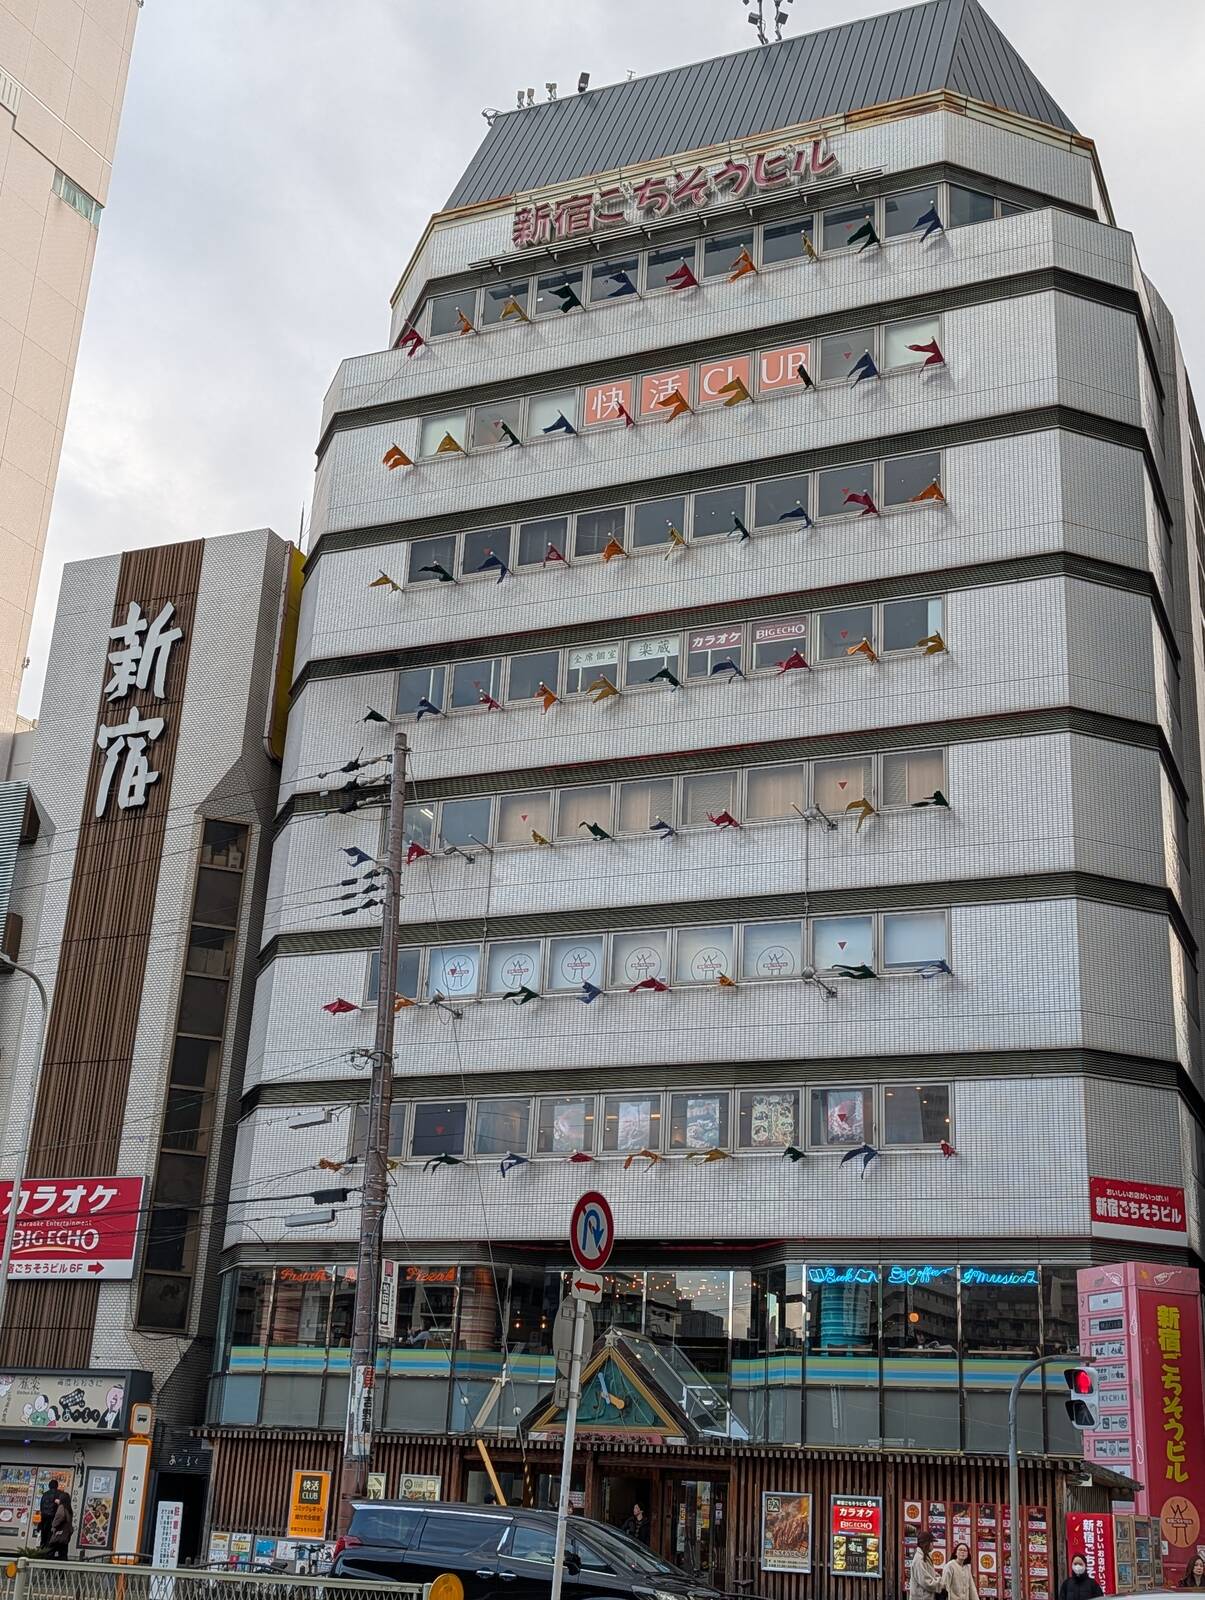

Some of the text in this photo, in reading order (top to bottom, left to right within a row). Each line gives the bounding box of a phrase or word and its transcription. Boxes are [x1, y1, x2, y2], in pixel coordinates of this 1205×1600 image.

[512, 140, 839, 249] 新宿ごちそうビル
[692, 632, 742, 648] カラオケ
[756, 624, 805, 640] BIG ECHO
[640, 640, 671, 657] 楽蔵
[95, 601, 183, 818] 新宿
[2, 1185, 118, 1215] カラオケ
[1095, 1197, 1182, 1224] 新宿ごちそうビル
[12, 1228, 99, 1250] BIG ECHO
[69, 1263, 83, 1273] 6F
[1157, 1305, 1189, 1483] 新宿ごちそうビル
[303, 1480, 320, 1491] 快活
[302, 1491, 319, 1500] CLUB
[839, 1508, 874, 1517] カラオケ
[840, 1521, 873, 1530] BIG ECHO
